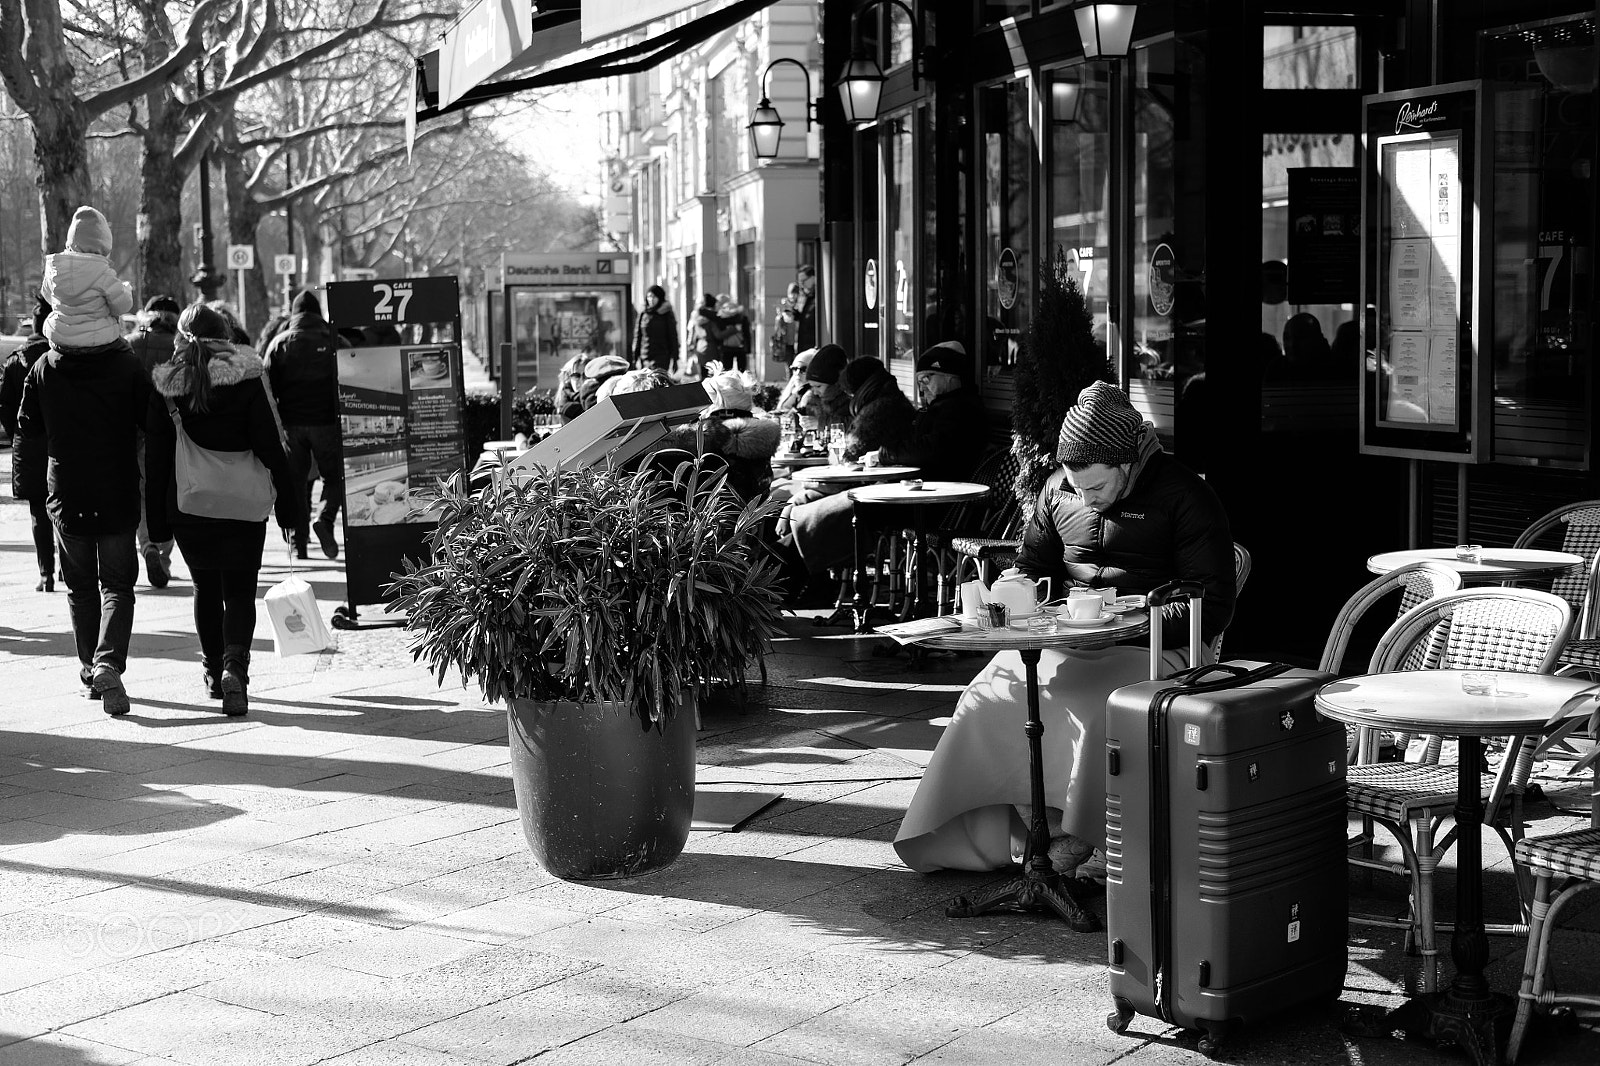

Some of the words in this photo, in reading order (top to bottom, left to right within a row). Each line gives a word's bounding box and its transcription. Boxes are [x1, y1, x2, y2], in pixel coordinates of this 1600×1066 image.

[1538, 230, 1565, 243] CAFE
[1079, 247, 1094, 258] CAFE
[507, 264, 560, 276] Deutsche
[563, 264, 592, 275] Bank
[373, 283, 413, 322] 27
